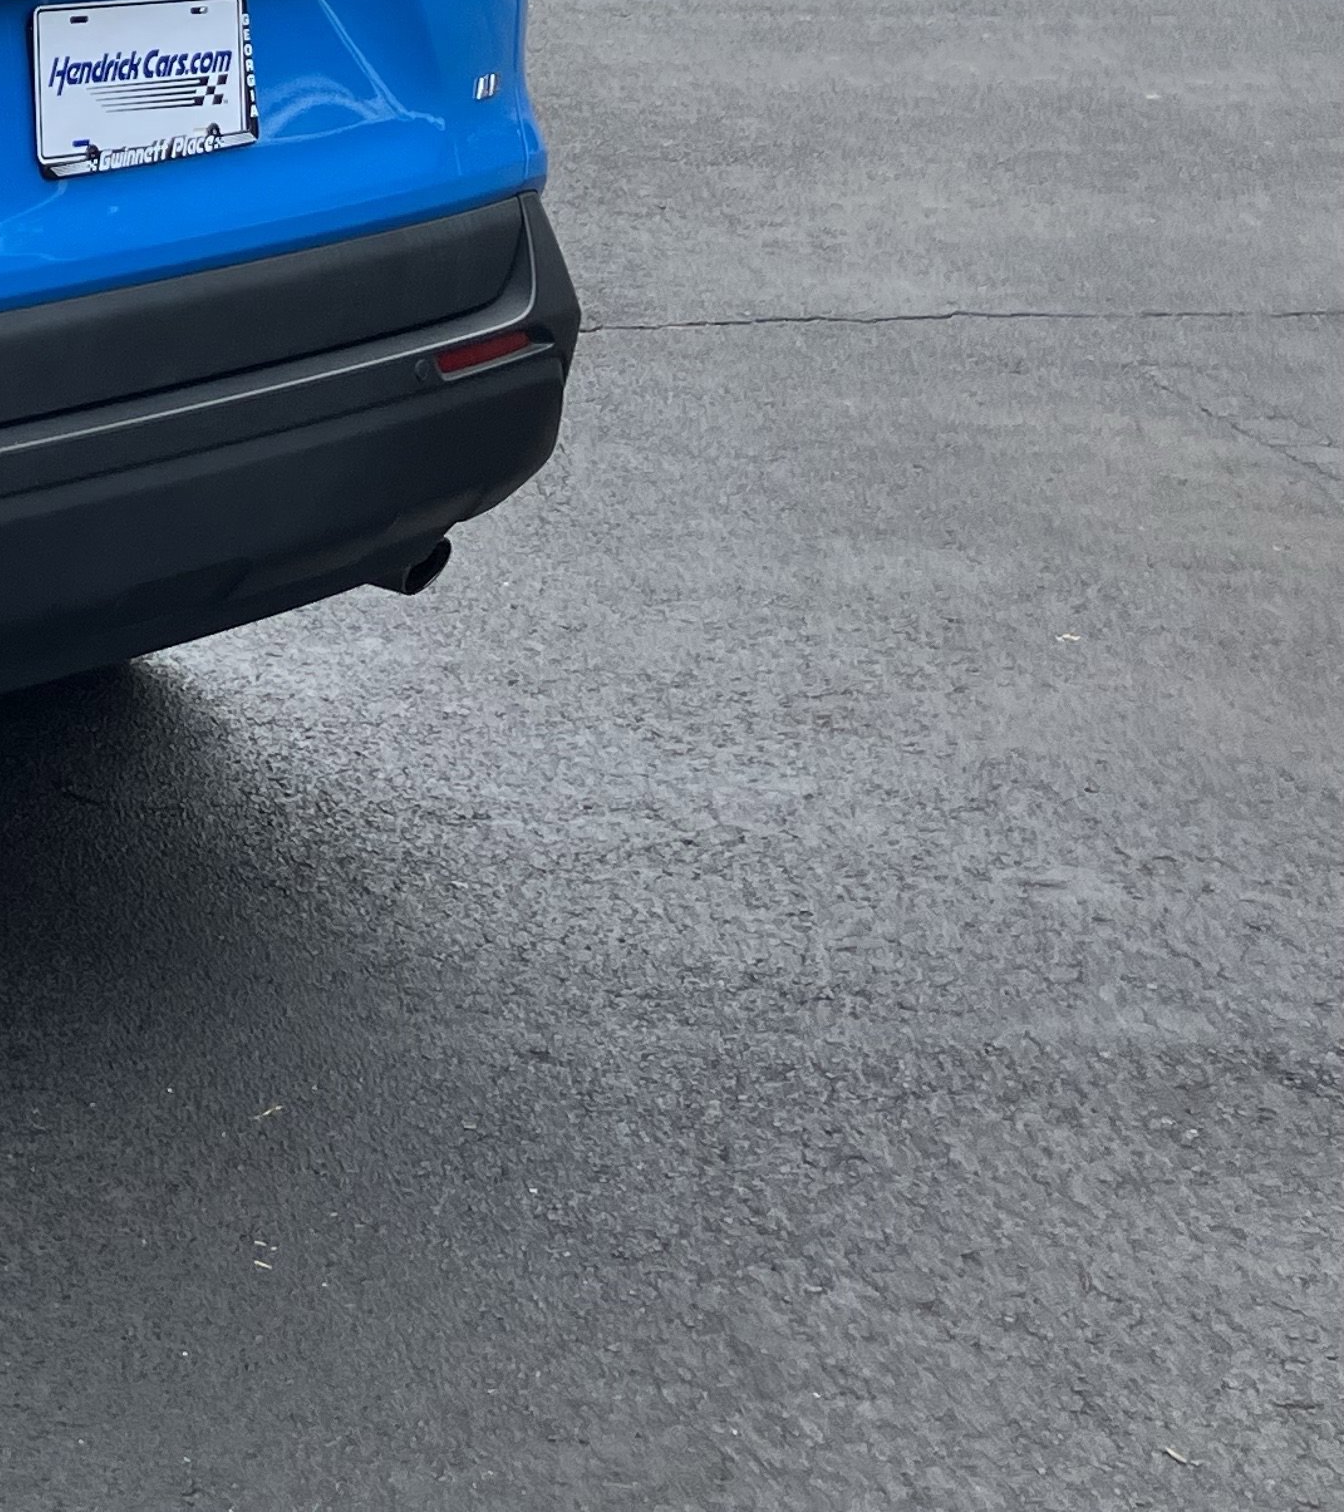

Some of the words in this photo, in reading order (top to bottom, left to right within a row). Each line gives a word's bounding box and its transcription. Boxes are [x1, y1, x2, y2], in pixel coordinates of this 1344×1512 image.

[242, 13, 260, 118] GEORGIA
[98, 138, 170, 171] Gwinnett
[171, 134, 214, 159] Place
